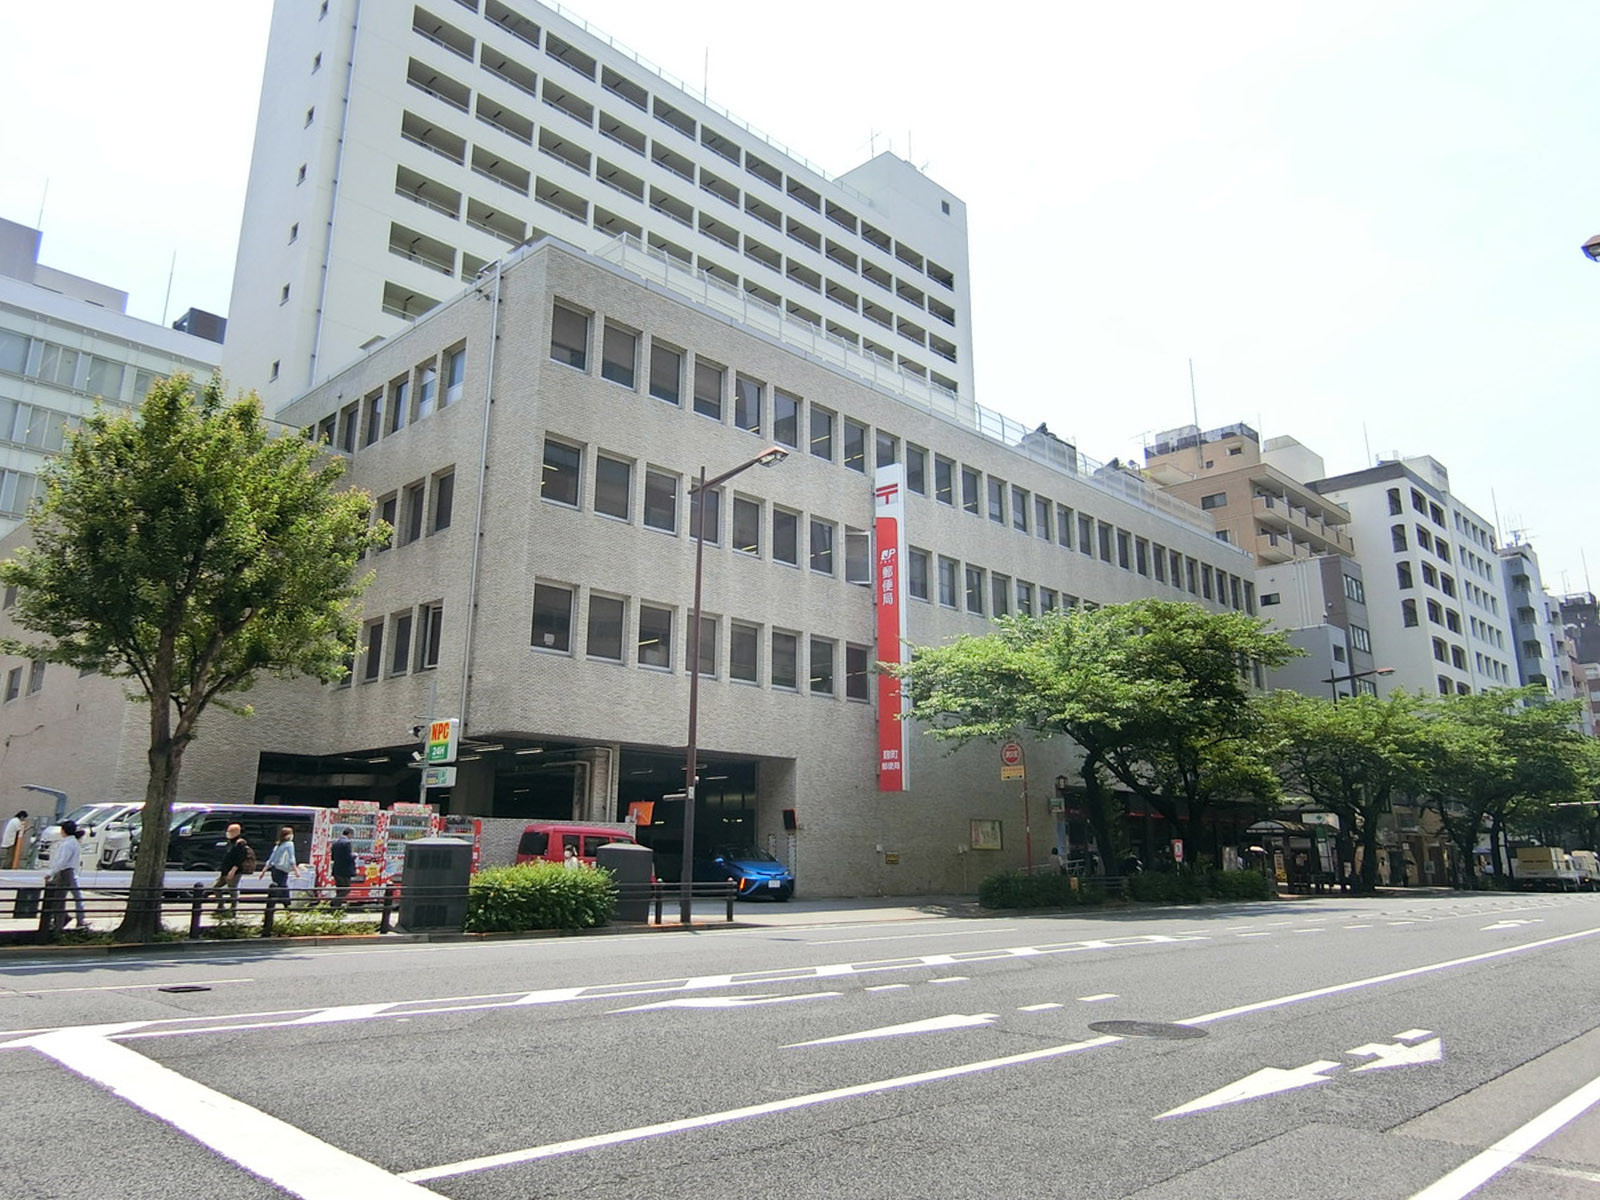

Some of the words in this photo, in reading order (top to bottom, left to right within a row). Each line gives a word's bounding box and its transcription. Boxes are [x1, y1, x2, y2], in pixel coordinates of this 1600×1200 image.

[882, 565, 894, 606] 郵便局
[431, 722, 450, 741] NPC
